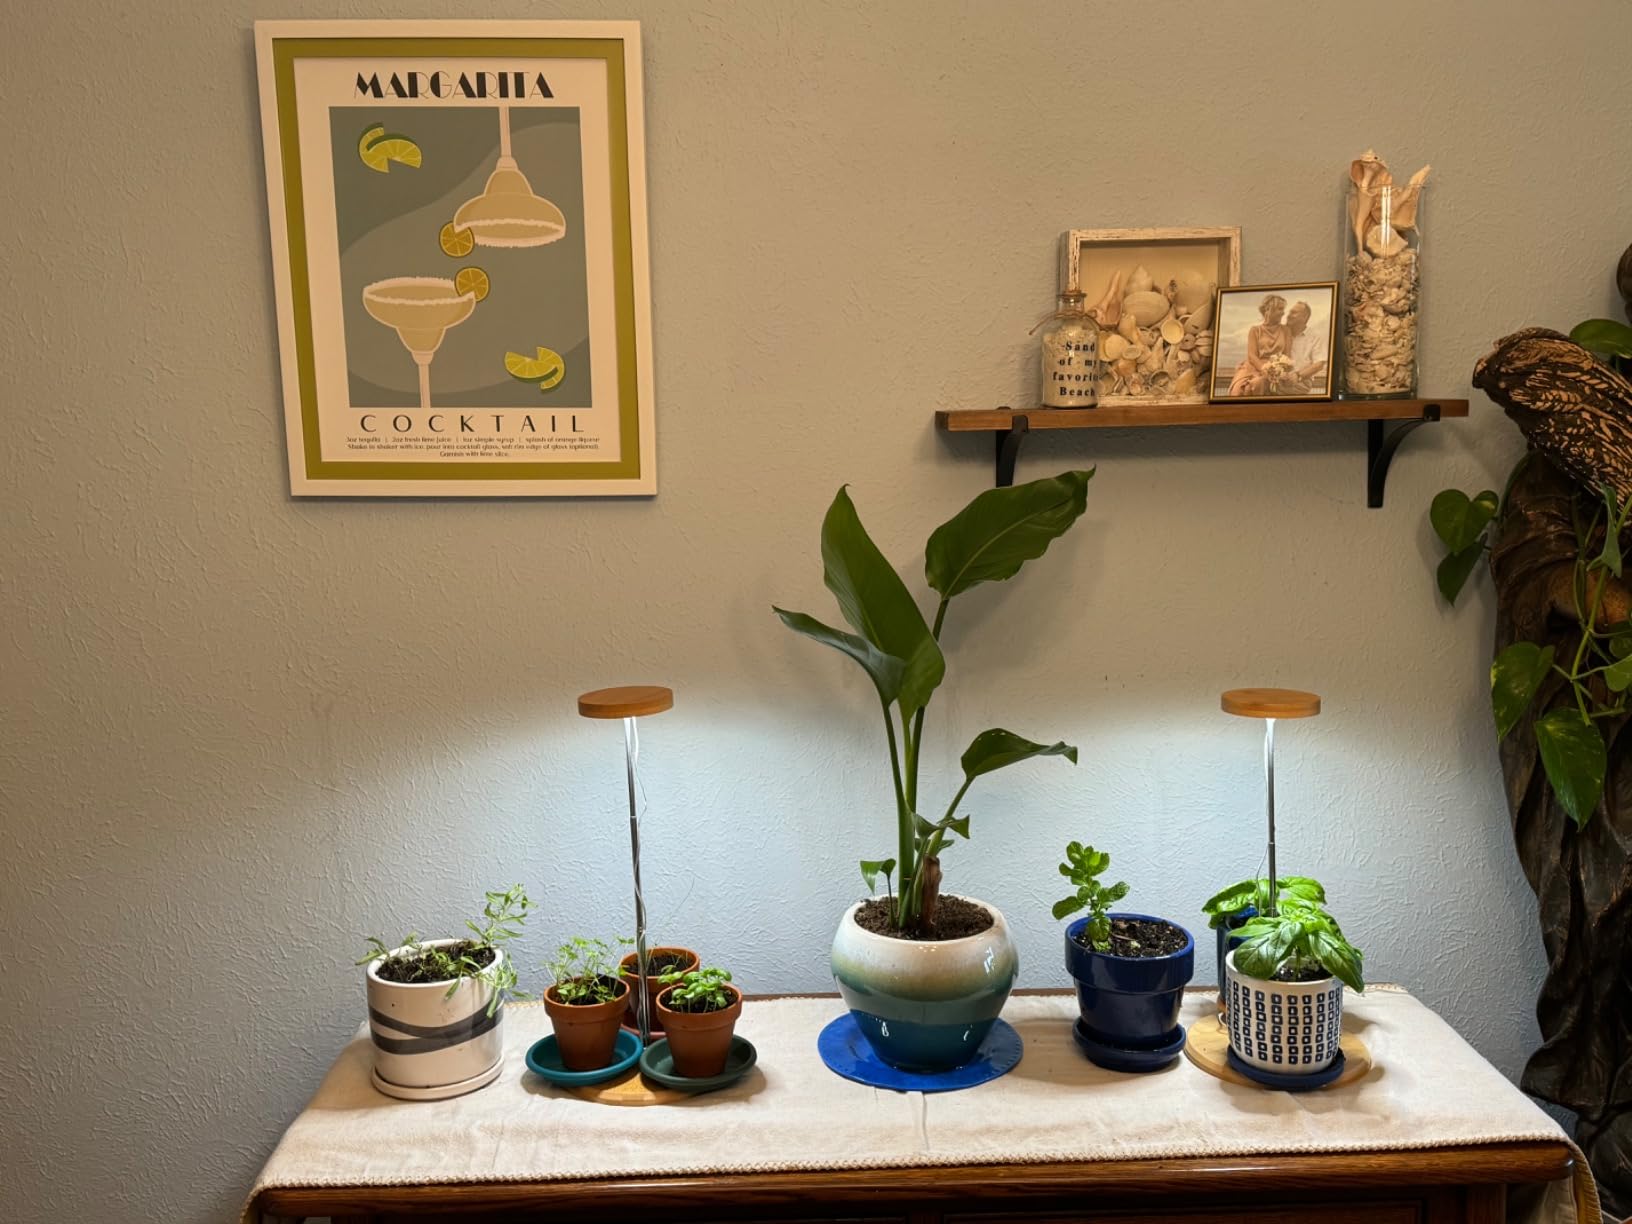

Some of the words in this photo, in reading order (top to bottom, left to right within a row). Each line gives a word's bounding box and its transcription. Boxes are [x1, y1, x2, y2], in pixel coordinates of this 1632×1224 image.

[354, 70, 554, 100] MARGARITA
[1065, 341, 1095, 352] Sand
[1059, 357, 1073, 366] of
[1060, 386, 1096, 397] Beach
[360, 414, 585, 433] COCKTAIL
